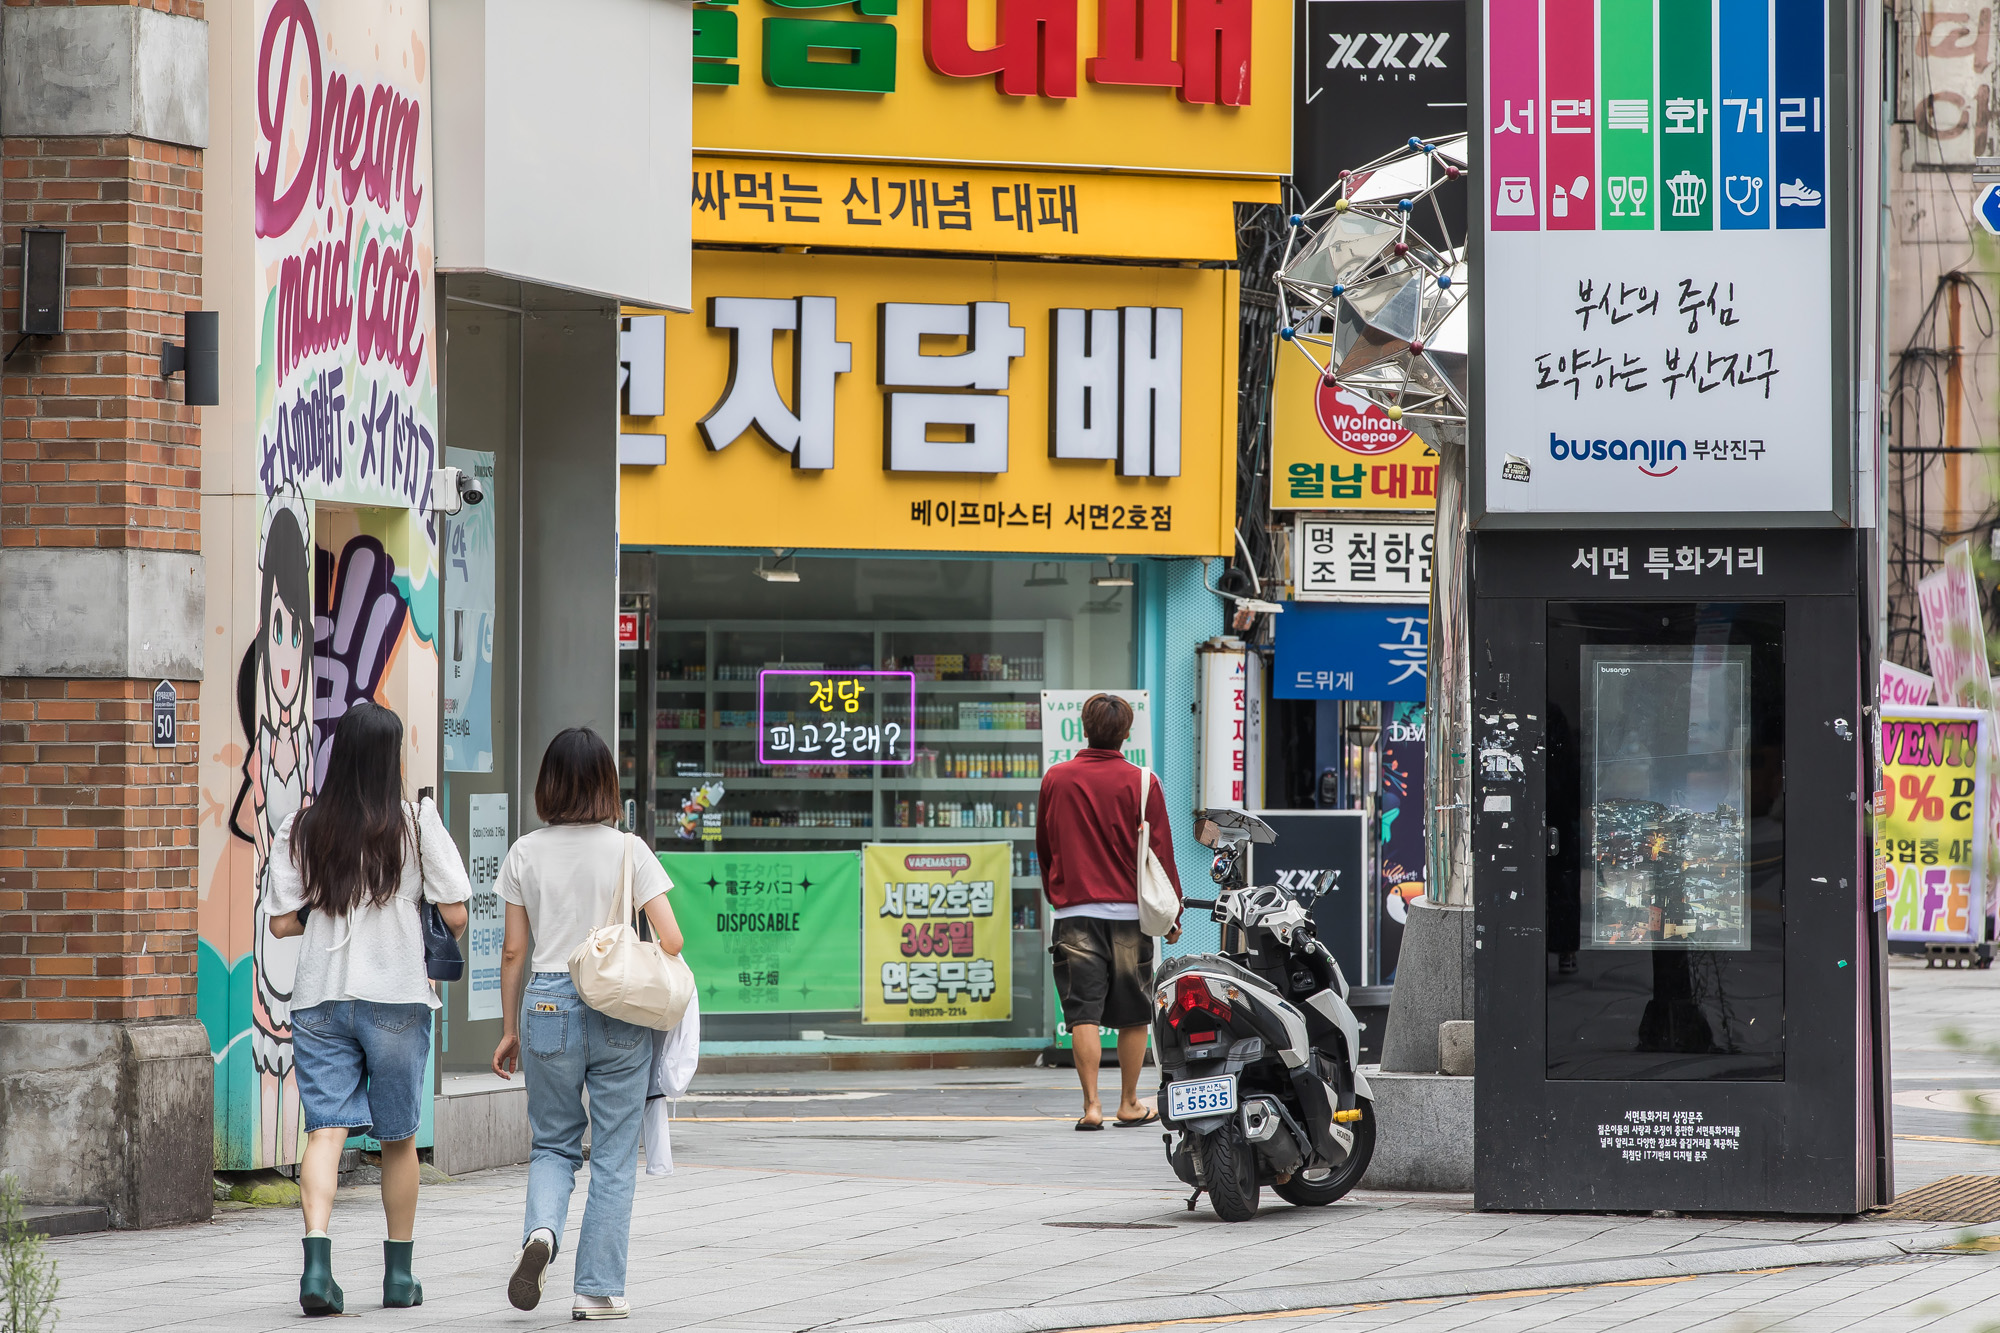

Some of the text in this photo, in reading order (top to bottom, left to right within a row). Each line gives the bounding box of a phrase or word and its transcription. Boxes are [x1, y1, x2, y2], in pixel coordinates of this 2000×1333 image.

[1326, 32, 1450, 69] XXX
[1360, 74, 1416, 82] HAIR
[255, 0, 422, 238] Dream
[842, 177, 972, 231] 신개념
[992, 183, 1079, 234] 대패
[277, 206, 354, 388] maid
[1575, 278, 1740, 334] 부산의 중심
[1535, 347, 1780, 400] 도약하는 부산진구
[1342, 431, 1398, 444] Daepae
[1550, 432, 1766, 469] busanjin 부산진구
[911, 499, 1172, 532] 베이프마스터 서면2호점
[1571, 546, 1763, 580] 서면 특화거리
[809, 679, 866, 713] 전담
[157, 714, 173, 738] 50
[770, 720, 901, 758] 피고갈래?
[1882, 721, 1978, 767] VENT!
[472, 856, 485, 884] 지금
[908, 857, 967, 868] VAPEMASTER
[880, 880, 994, 918] 서면2호점
[717, 913, 800, 932] DISPOSABLE
[901, 921, 974, 957] 365일
[738, 970, 779, 987] 电子烟
[881, 959, 995, 1004] 연중무휴
[1188, 1092, 1228, 1111] 5535
[1624, 1111, 1704, 1124] 서면특화거리 상징문주
[1597, 1125, 1630, 1136] 젊은이들의
[1632, 1125, 1651, 1136] 사랑과
[1696, 1126, 1740, 1138] 서면특화거리를
[1713, 1139, 1740, 1150] 제공하는
[1622, 1150, 1641, 1161] 최첨단
[1673, 1150, 1692, 1162] 디지털
